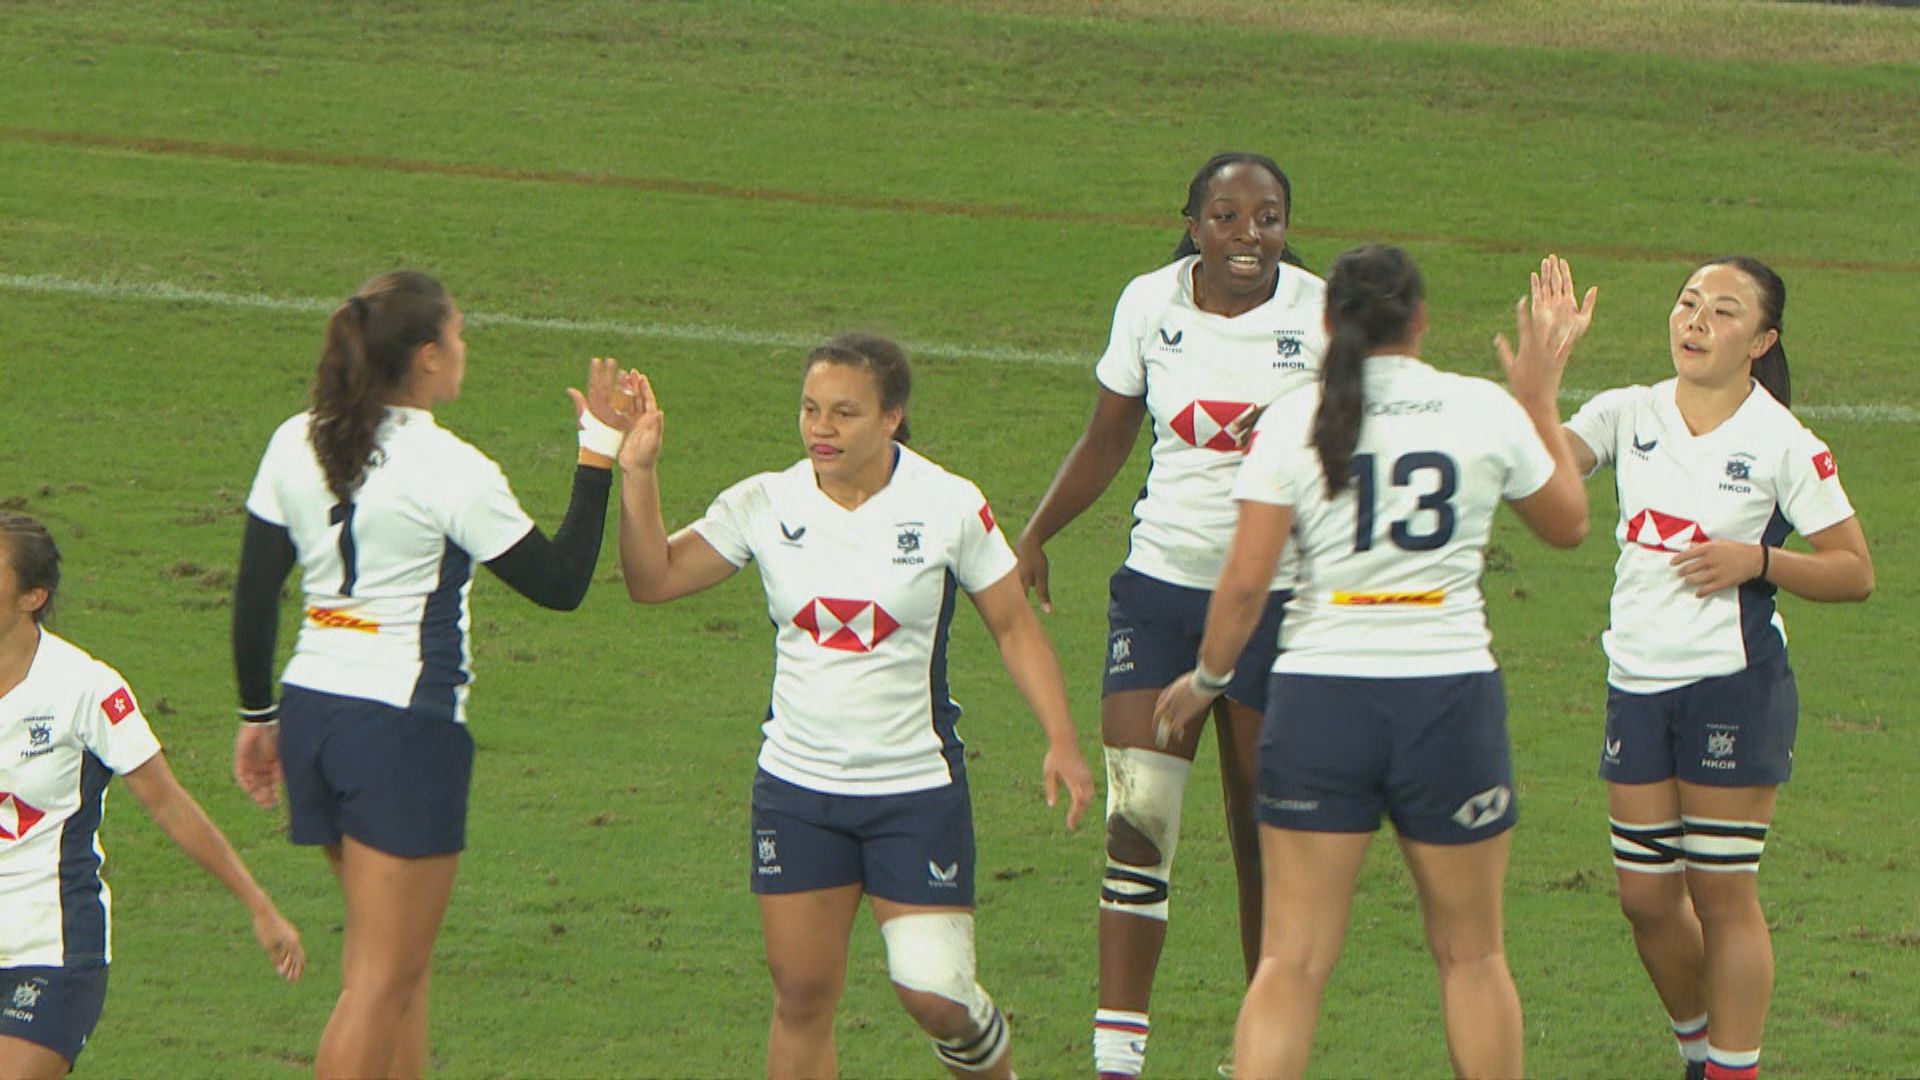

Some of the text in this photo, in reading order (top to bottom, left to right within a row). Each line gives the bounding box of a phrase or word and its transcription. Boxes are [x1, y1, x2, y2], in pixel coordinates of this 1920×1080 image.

[1350, 451, 1456, 552] 13
[1718, 481, 1752, 495] HKCR
[329, 500, 358, 598] 1
[1701, 758, 1737, 770] HKCR
